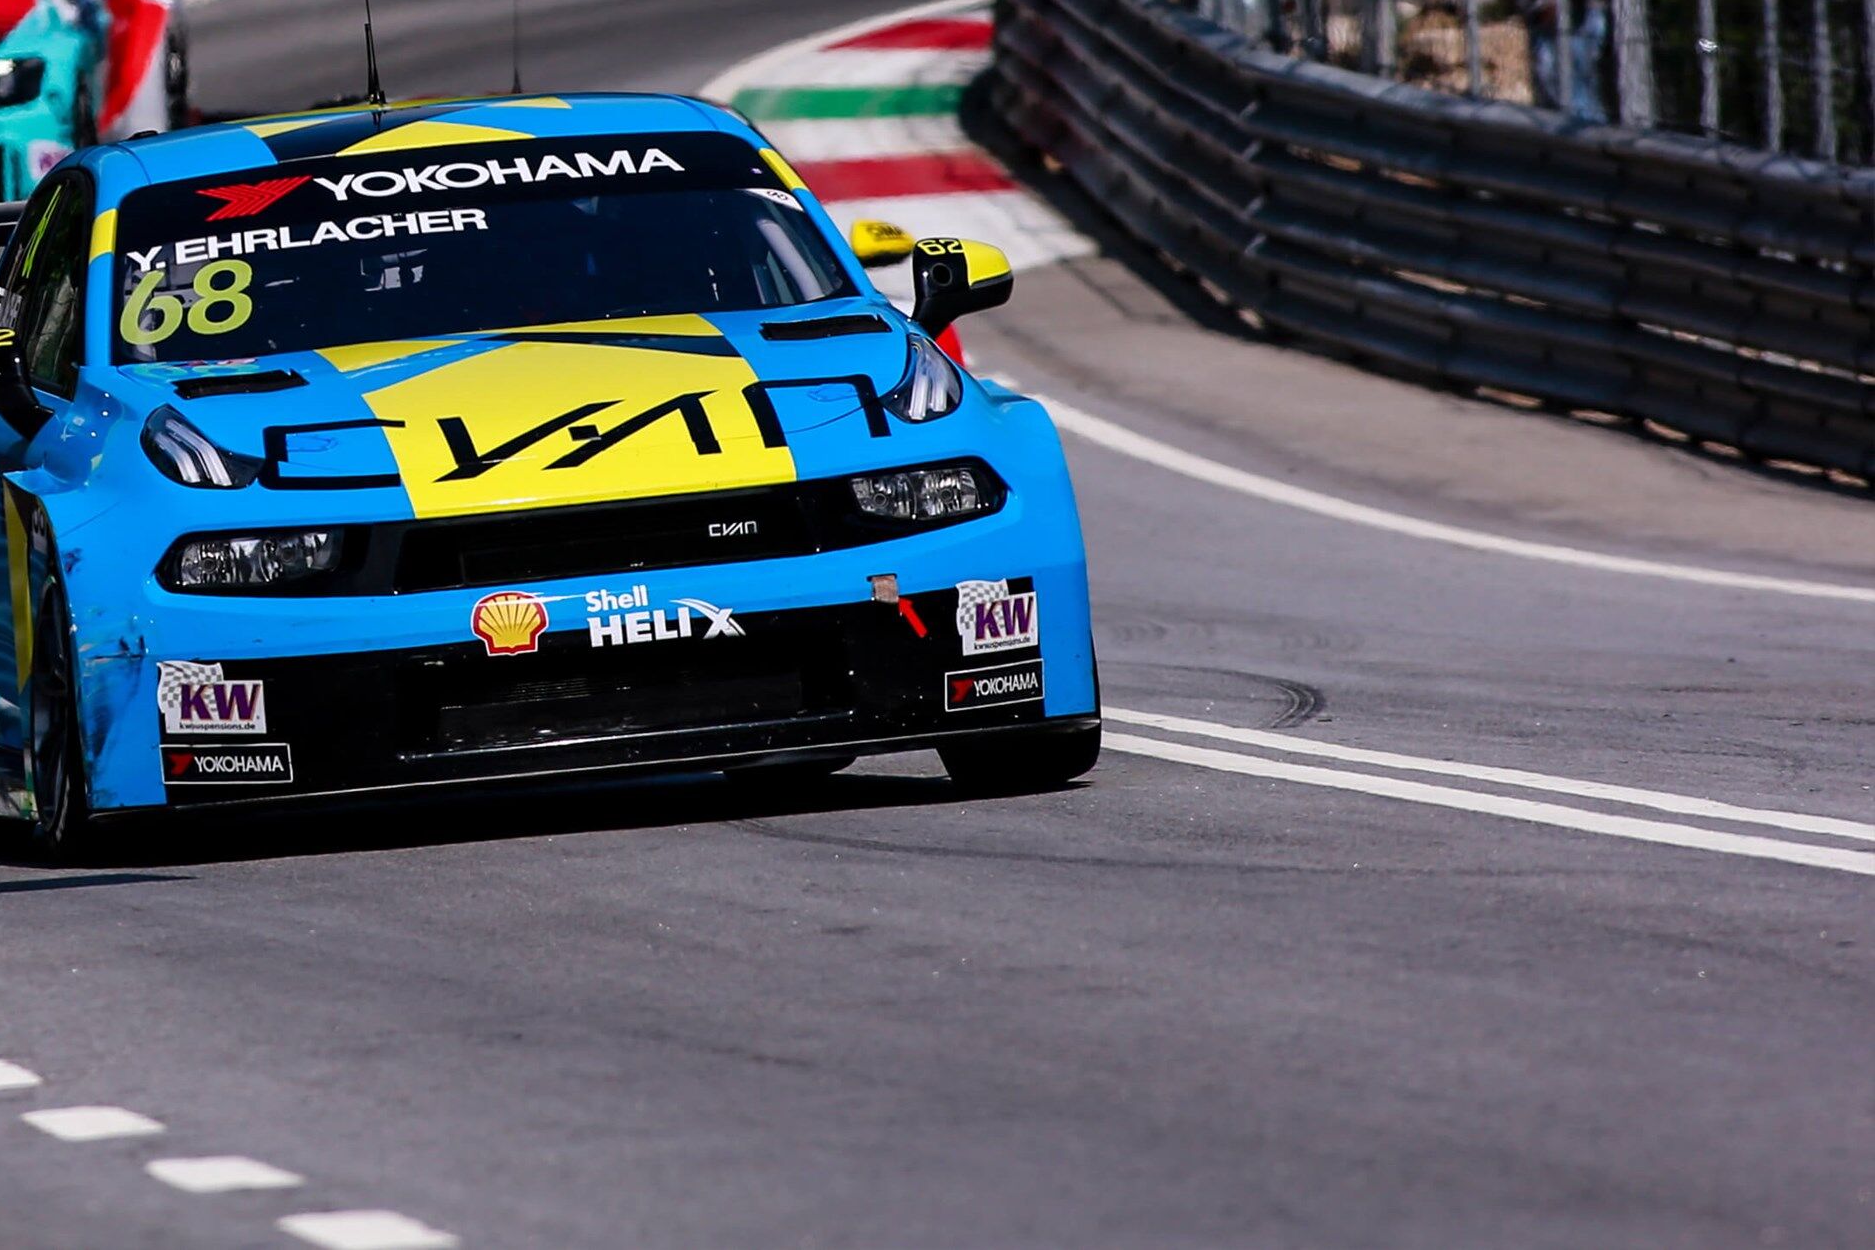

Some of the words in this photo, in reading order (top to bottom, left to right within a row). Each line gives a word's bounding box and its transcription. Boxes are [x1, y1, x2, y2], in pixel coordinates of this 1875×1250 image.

[314, 148, 685, 201] YOKOHAMA
[127, 248, 164, 272] Y.
[175, 208, 488, 266] EHRLACHER
[120, 259, 253, 346] 68
[584, 585, 648, 611] Shell
[975, 595, 1034, 641] KW
[587, 598, 745, 647] HELIX
[180, 682, 261, 721] KW
[973, 671, 1039, 698] YOKOHAMA
[194, 755, 285, 773] YOKOHAMA
